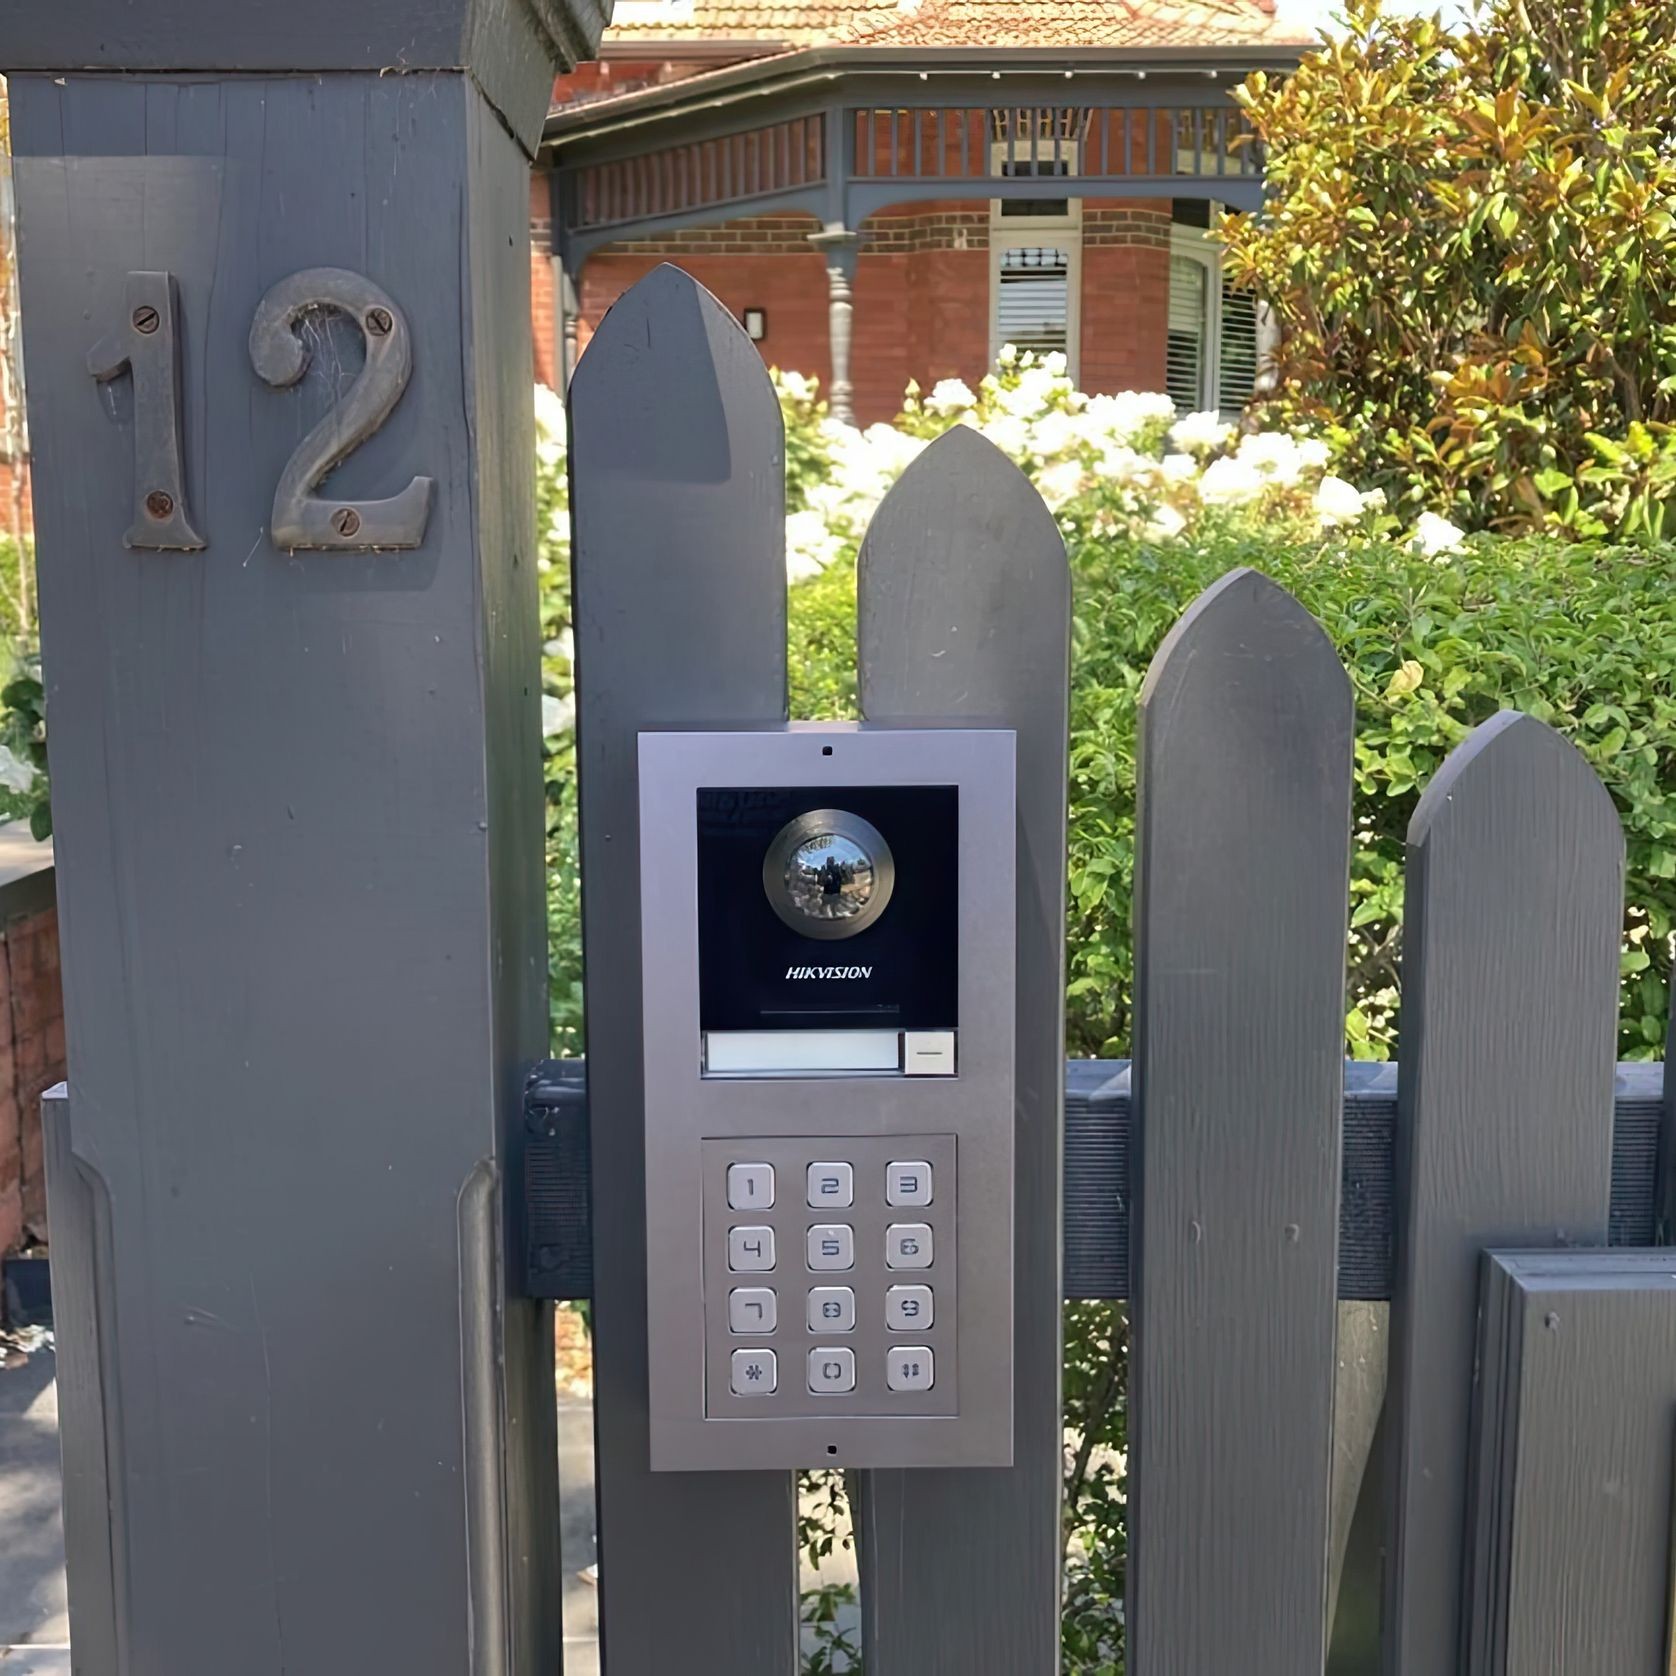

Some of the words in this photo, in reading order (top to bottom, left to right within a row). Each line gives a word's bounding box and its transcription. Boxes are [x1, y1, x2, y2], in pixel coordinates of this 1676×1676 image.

[86, 266, 437, 552] 12
[784, 966, 873, 980] HIKVISION
[821, 1178, 839, 1194] 2
[900, 1176, 918, 1193] 3
[743, 1240, 761, 1258] 4
[822, 1240, 839, 1256] 5
[900, 1238, 919, 1256] 6
[745, 1303, 762, 1320] 7
[822, 1302, 841, 1318] 8
[901, 1300, 920, 1317] 9
[823, 1363, 842, 1379] 0
